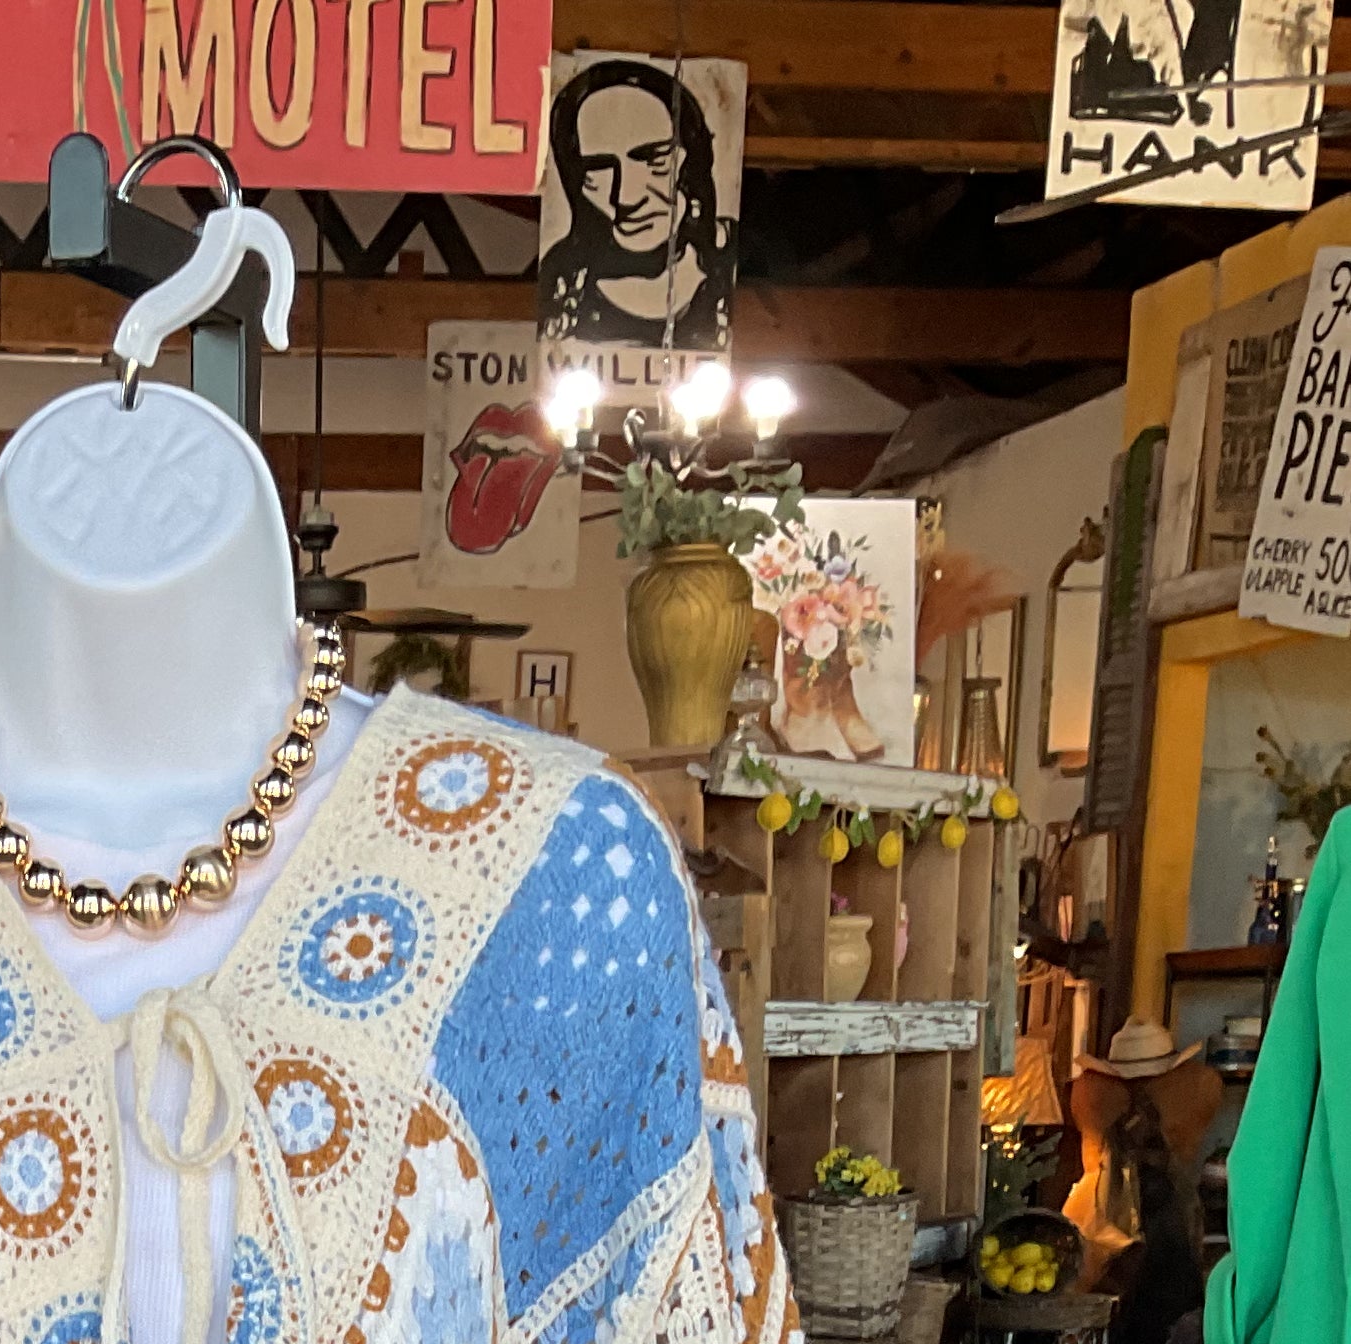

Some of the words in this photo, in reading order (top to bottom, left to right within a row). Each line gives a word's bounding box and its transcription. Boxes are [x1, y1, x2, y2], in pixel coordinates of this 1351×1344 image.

[141, 0, 527, 153] MOTEL
[1060, 131, 1306, 179] HANK
[432, 351, 528, 386] STON
[547, 352, 716, 386] WILLI
[1253, 536, 1312, 565] CHERRY
[1315, 537, 1351, 584] 50
[530, 664, 556, 697] H
